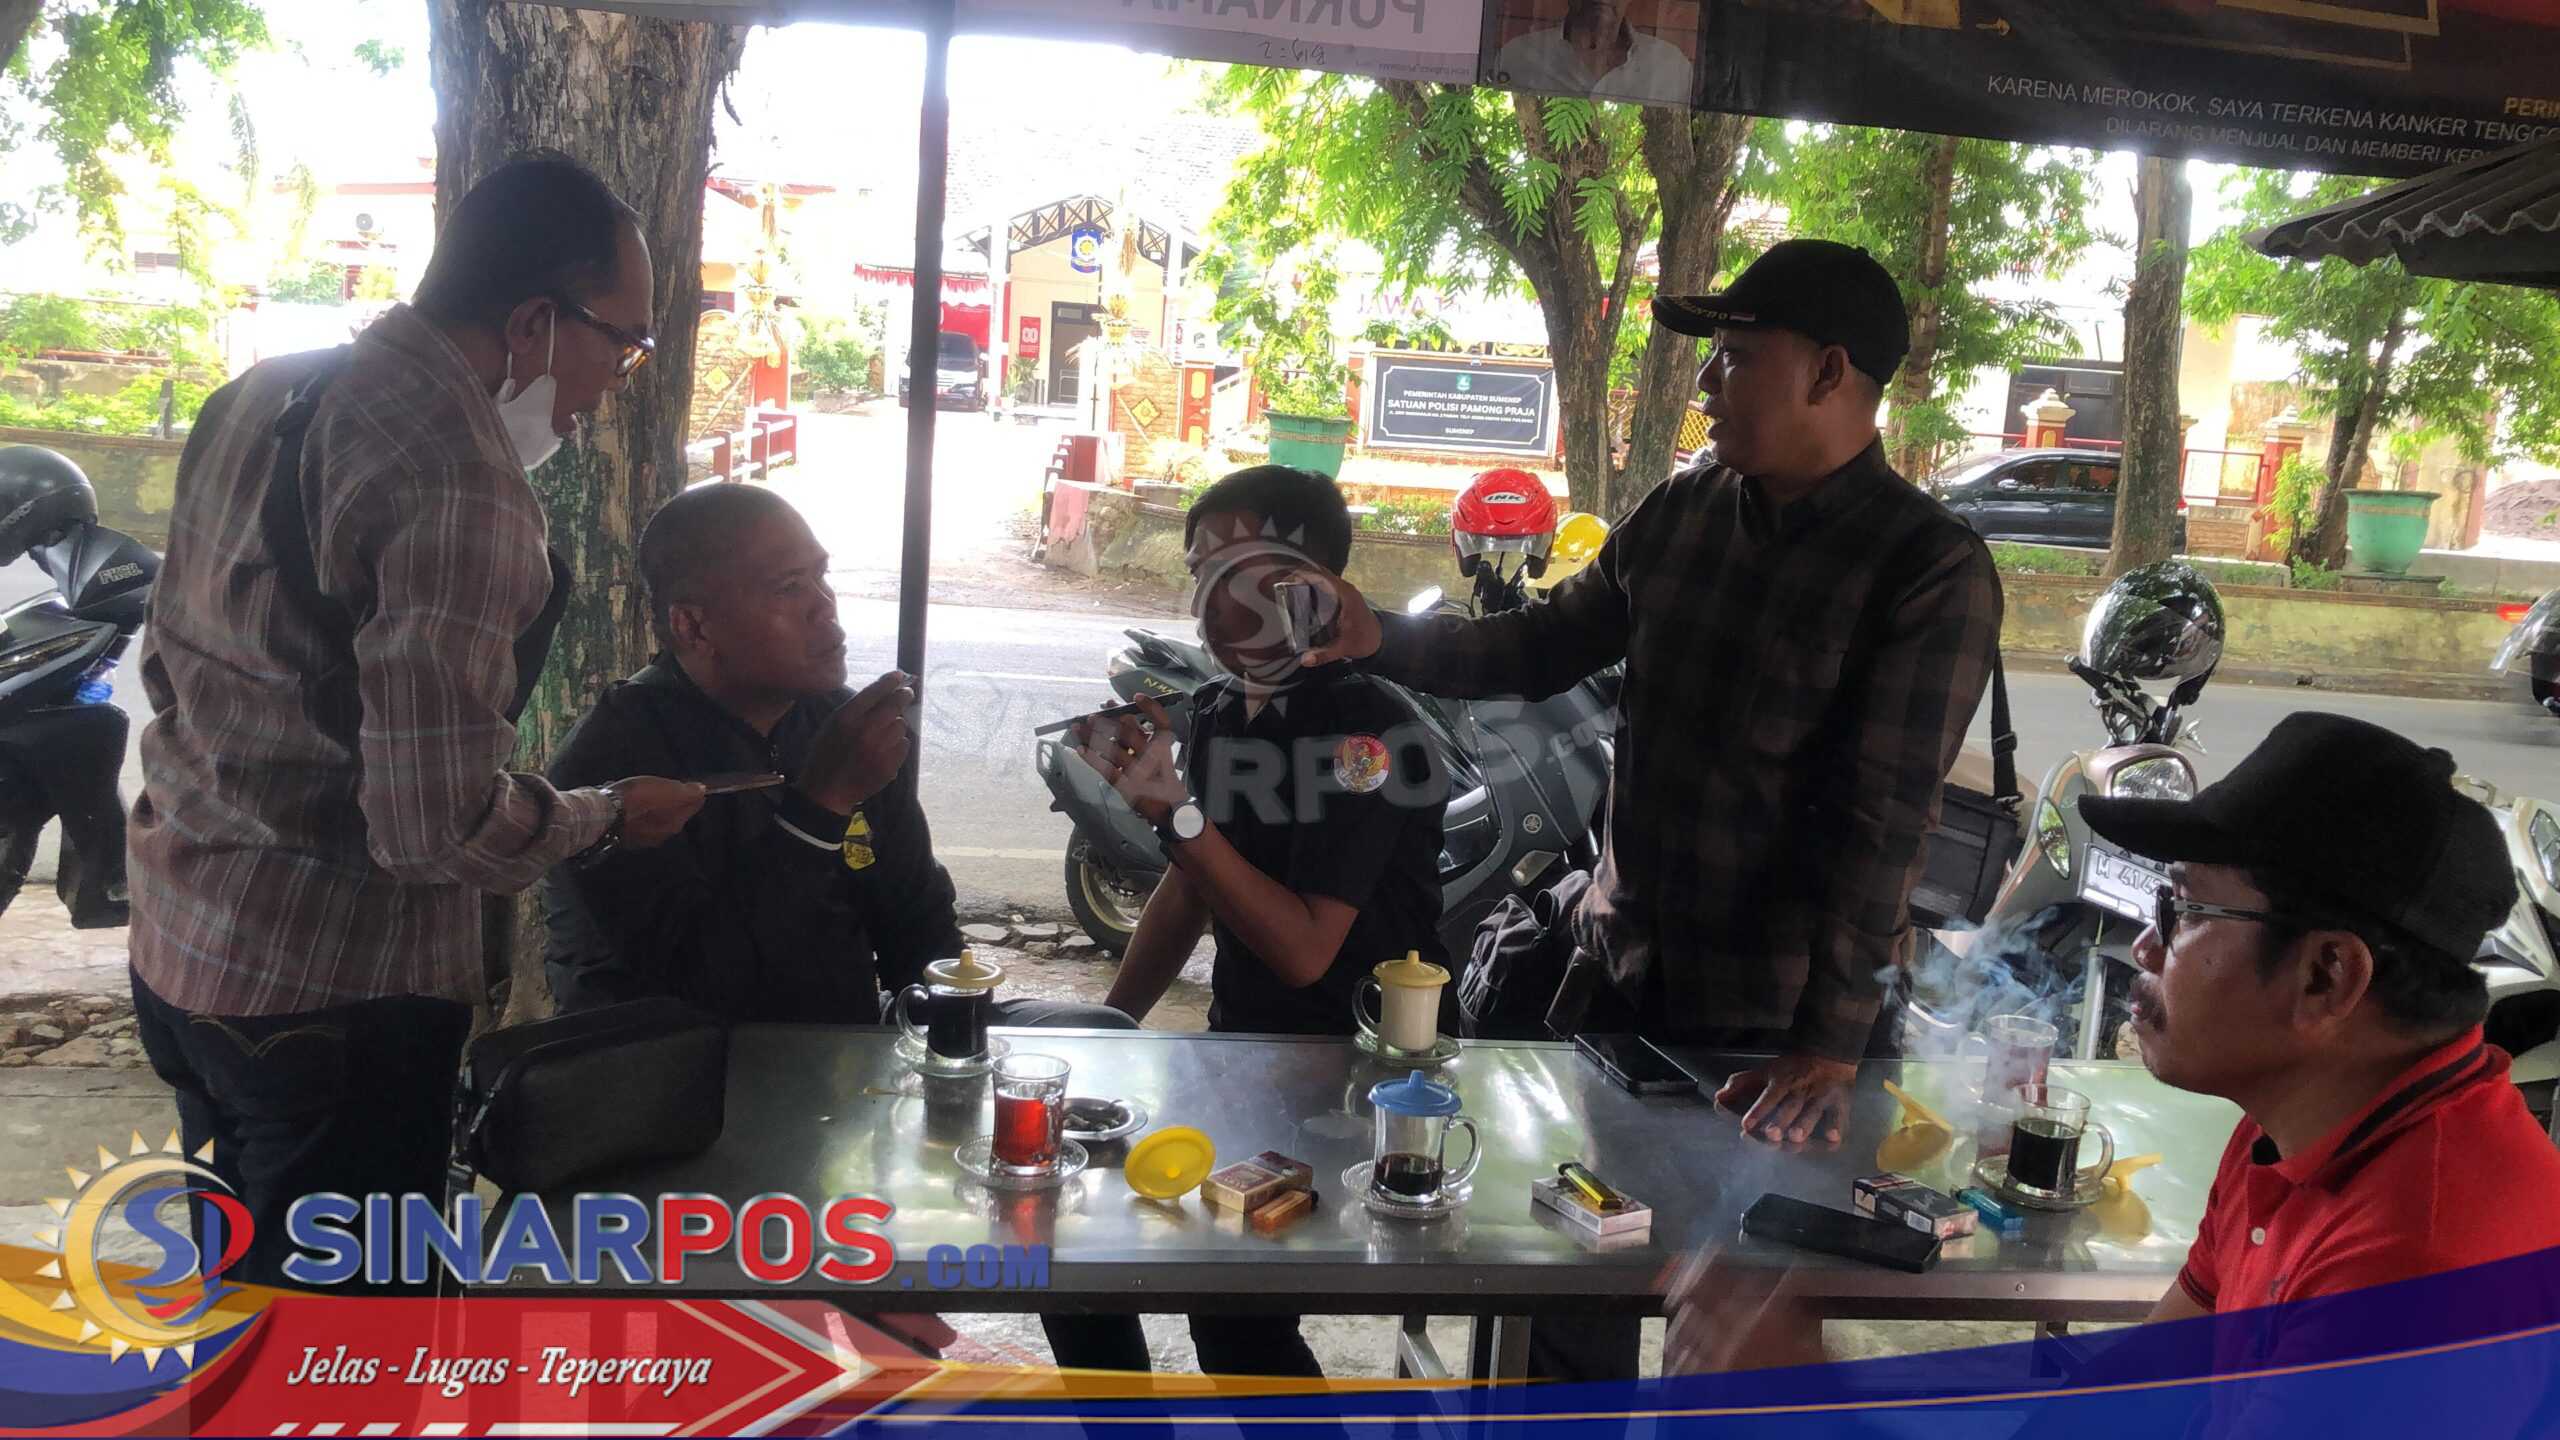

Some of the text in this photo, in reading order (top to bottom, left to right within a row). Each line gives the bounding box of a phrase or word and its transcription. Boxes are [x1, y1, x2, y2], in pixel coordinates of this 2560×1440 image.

[1987, 76, 2077, 101] KARENA
[2208, 97, 2264, 120] SAYA
[2271, 103, 2373, 129] TERKENA
[2379, 112, 2467, 137] KANKER
[2209, 127, 2300, 149] MENJUAL
[2304, 135, 2346, 155] DAN
[2351, 140, 2440, 163] MEMBERI
[1388, 399, 1427, 410] SATUAN
[1428, 401, 1459, 412] POLISI
[1460, 403, 1503, 415] PAMONG
[1504, 406, 1536, 417] PRAJA
[1403, 389, 1447, 399] PEMERINTAH
[1448, 392, 1489, 402] KABUPATEN
[2095, 854, 2111, 879] M
